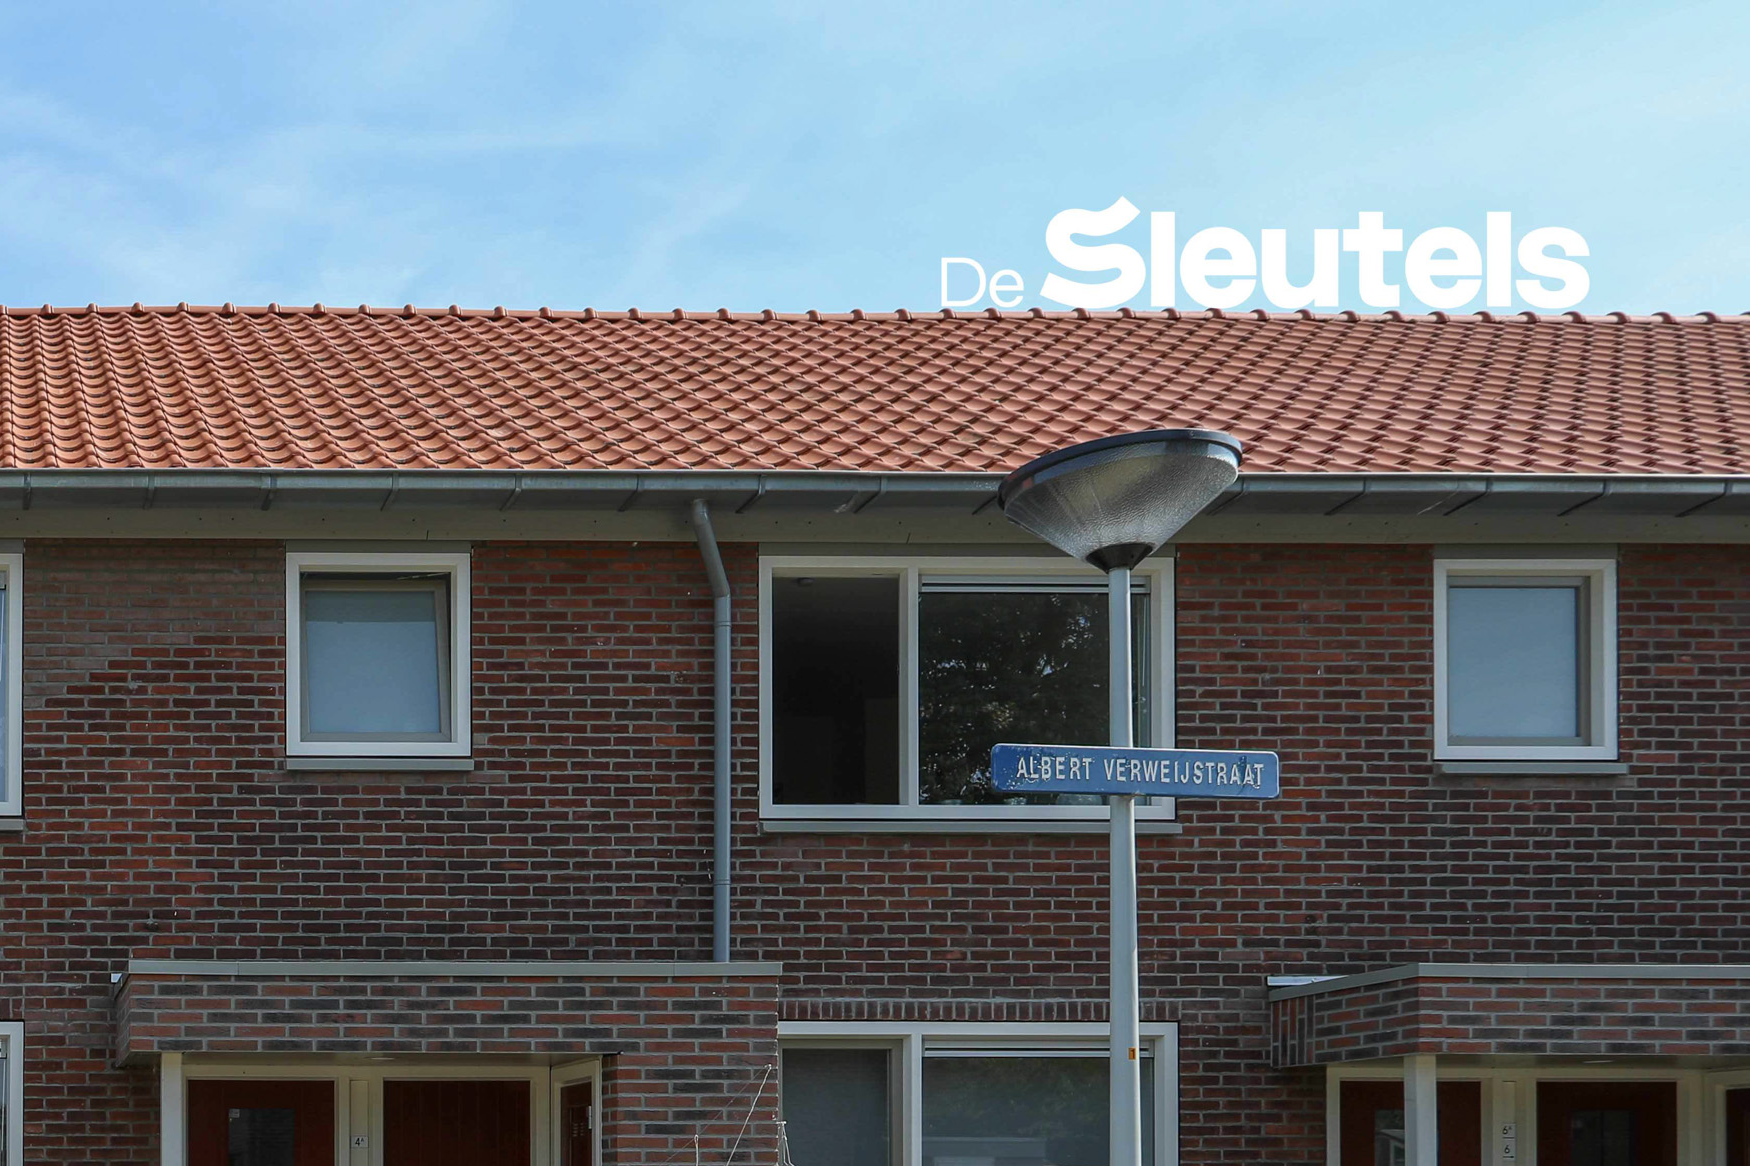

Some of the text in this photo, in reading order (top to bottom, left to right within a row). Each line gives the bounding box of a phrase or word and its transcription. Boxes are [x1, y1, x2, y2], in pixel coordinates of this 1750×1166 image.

[1016, 756, 1265, 787] ALBERT VERWEIJSTRAAT
[1504, 1145, 1511, 1154] 6
